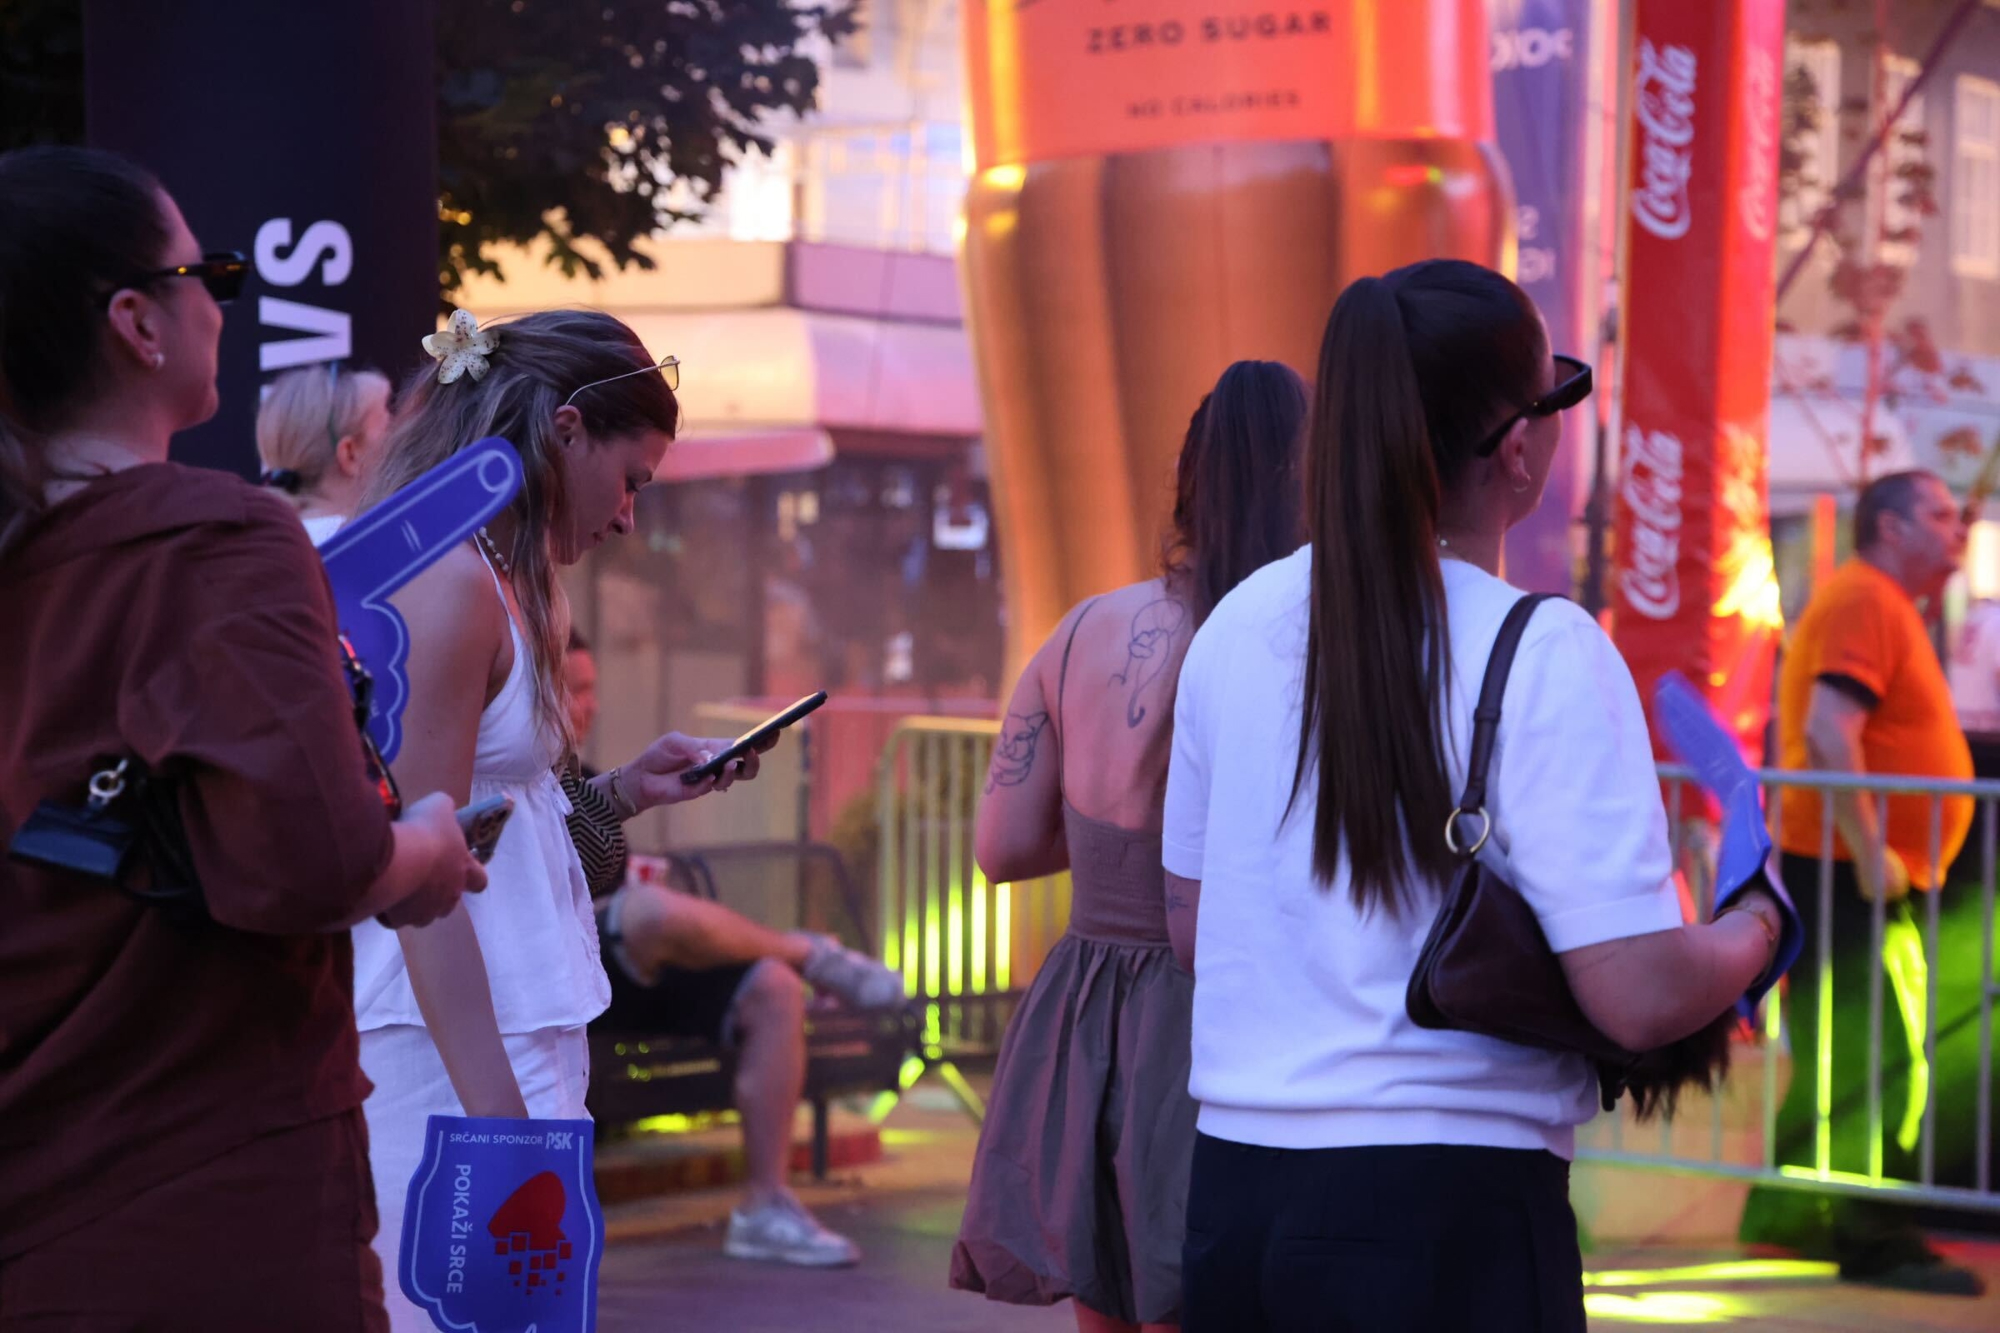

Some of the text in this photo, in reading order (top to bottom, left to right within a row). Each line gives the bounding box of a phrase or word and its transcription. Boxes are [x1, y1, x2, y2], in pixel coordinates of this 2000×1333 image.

[1087, 11, 1331, 53] ZERO SUGAR
[449, 1131, 574, 1150] SRČANI SPONZOR PSK
[446, 1164, 473, 1294] POKAŽI SRCE
